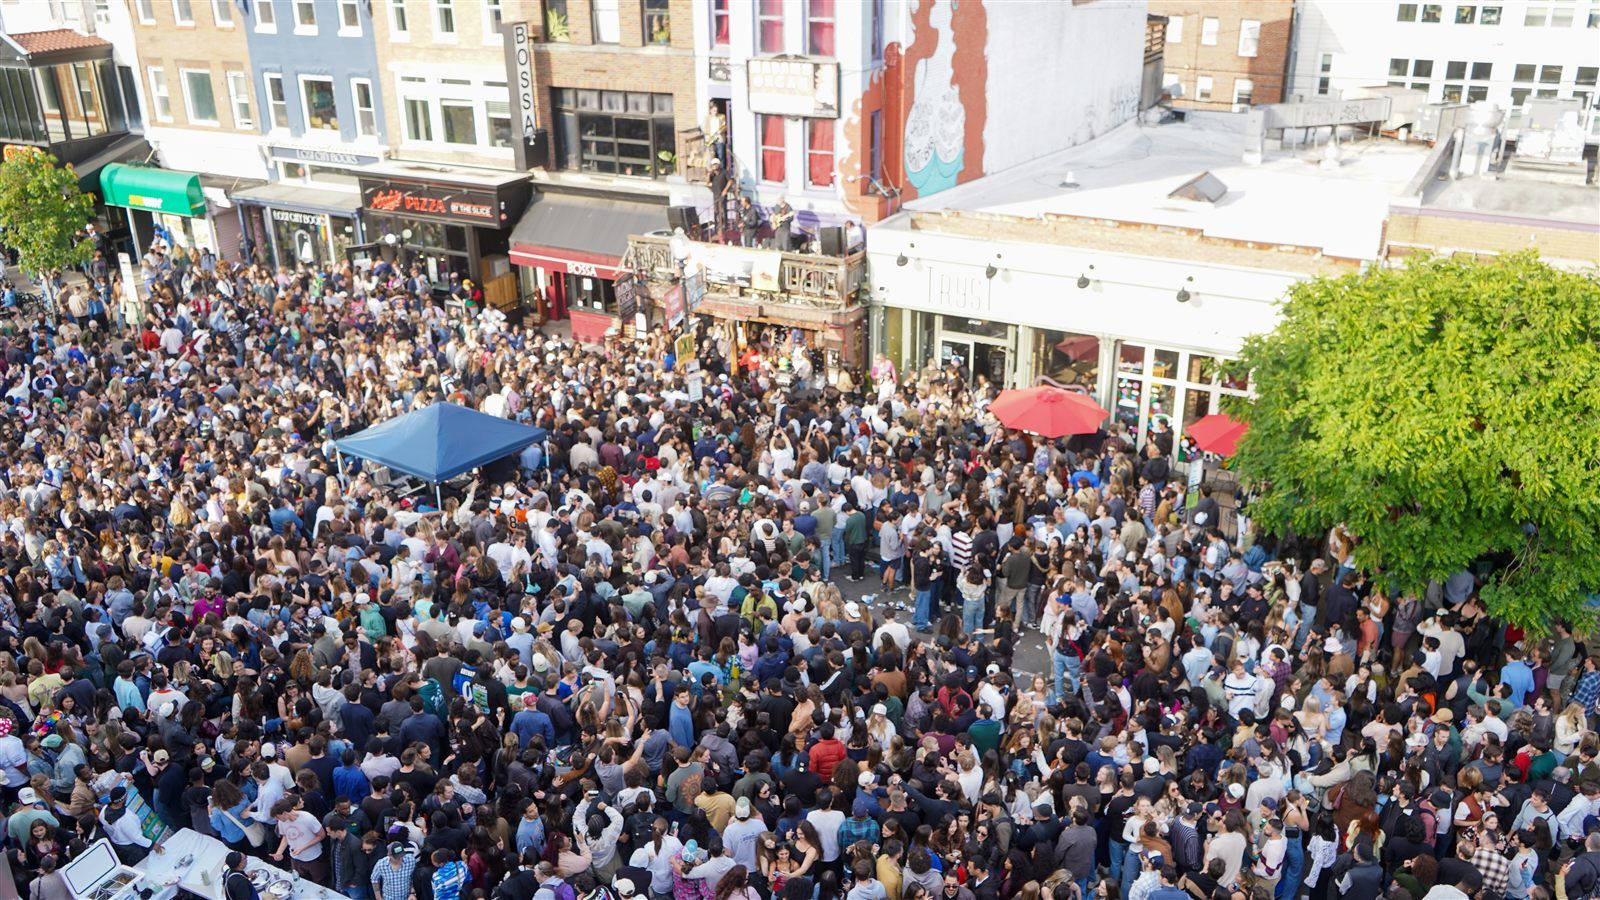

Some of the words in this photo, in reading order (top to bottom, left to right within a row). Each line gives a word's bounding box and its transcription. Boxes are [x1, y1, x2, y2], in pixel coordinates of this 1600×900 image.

[515, 26, 535, 133] BOSSA
[405, 196, 447, 213] PIZZA
[567, 262, 598, 277] BOSSA
